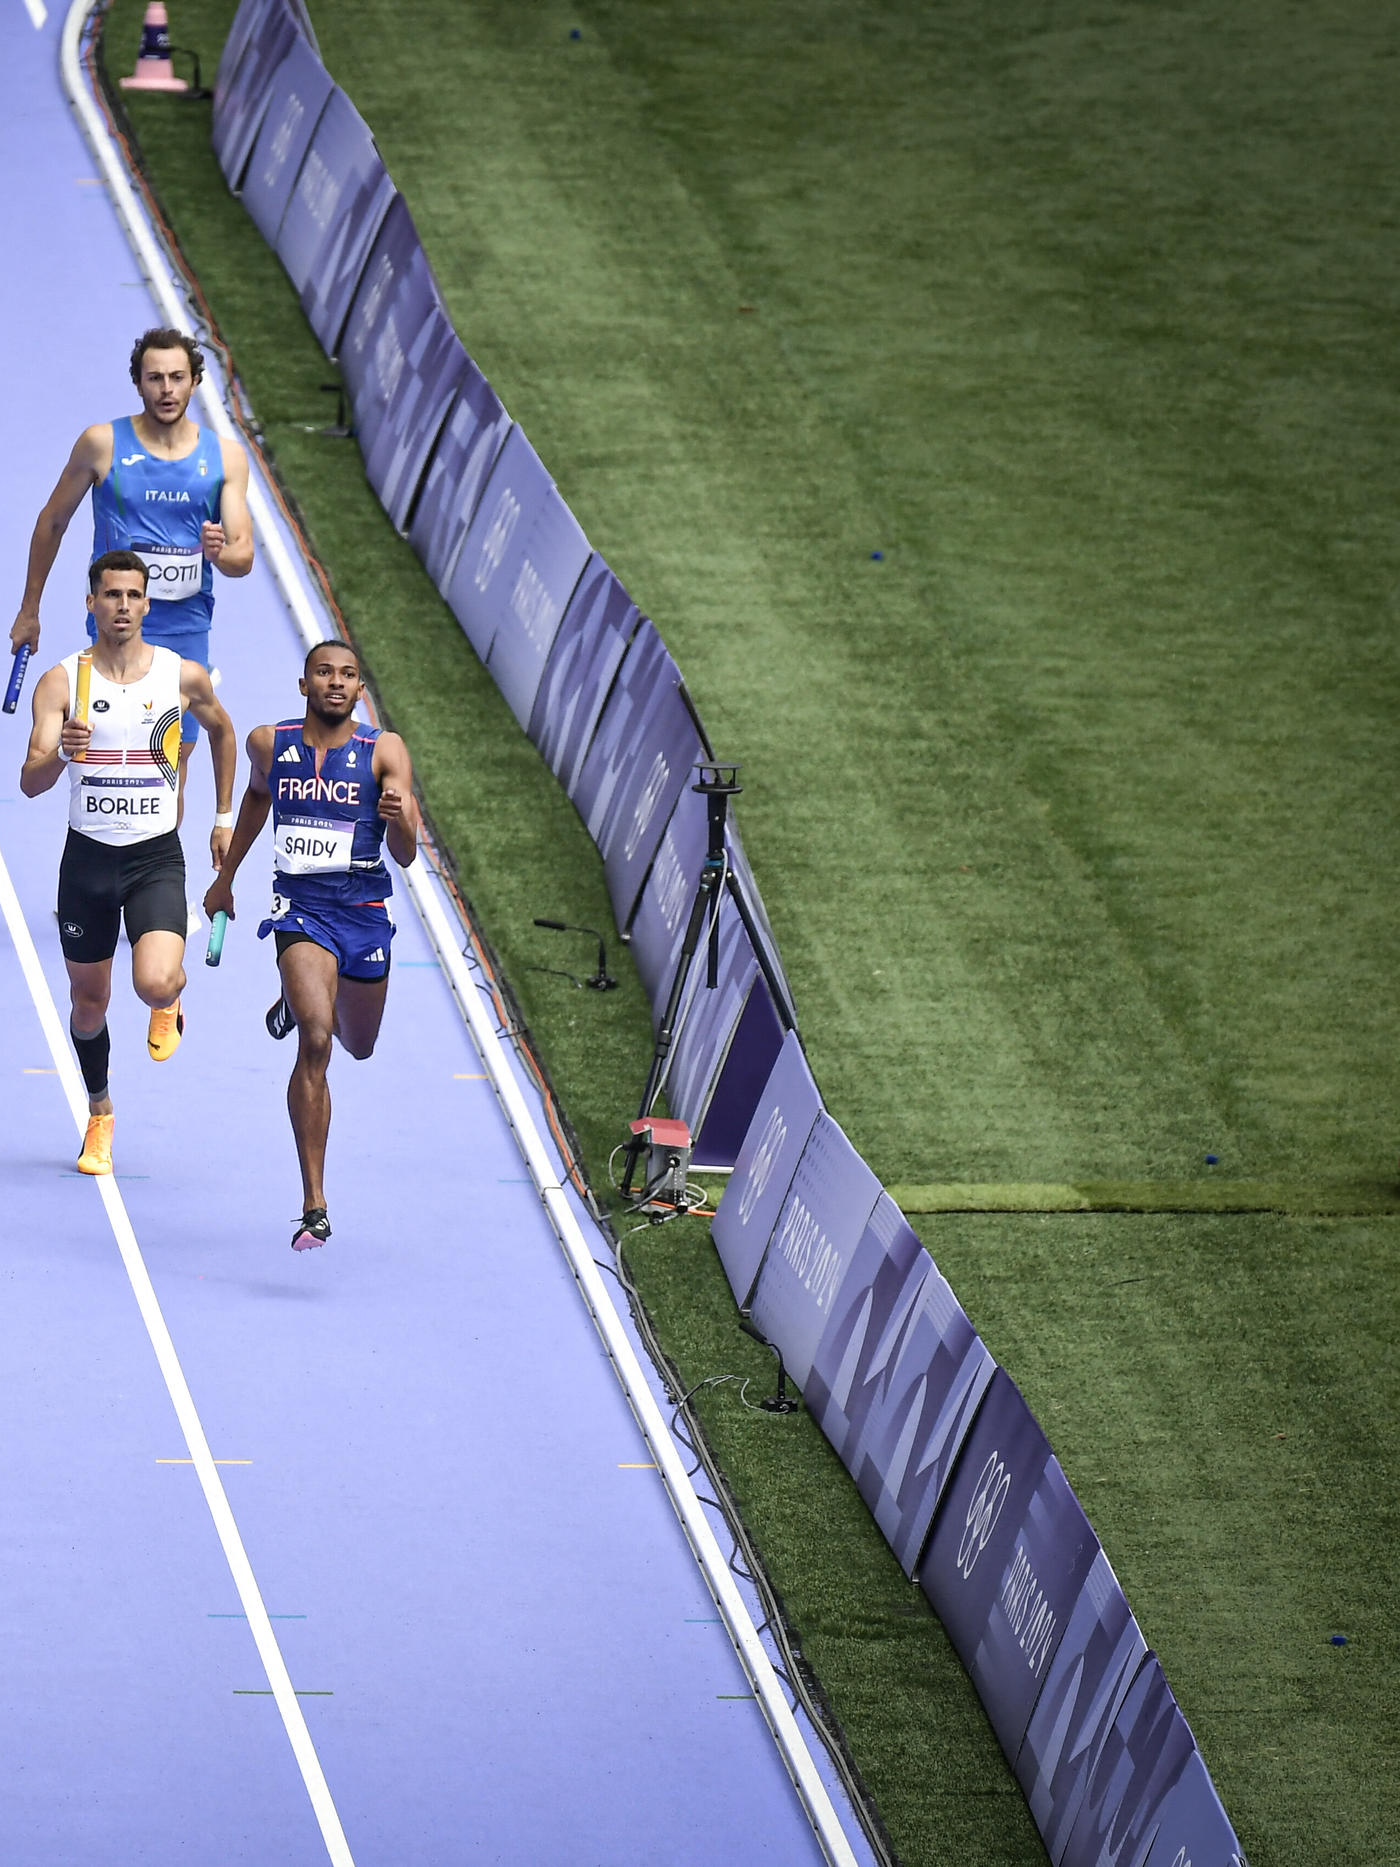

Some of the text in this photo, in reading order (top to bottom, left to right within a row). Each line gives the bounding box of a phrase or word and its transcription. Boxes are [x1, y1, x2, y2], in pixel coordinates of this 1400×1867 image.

[145, 490, 190, 502] ITALIA
[147, 564, 198, 582] COTTI
[278, 777, 361, 805] FRANCE
[86, 796, 160, 815] BORLEE
[285, 836, 338, 859] SAIDY
[271, 895, 281, 914] 3
[1019, 1590, 1057, 1679] 2024
